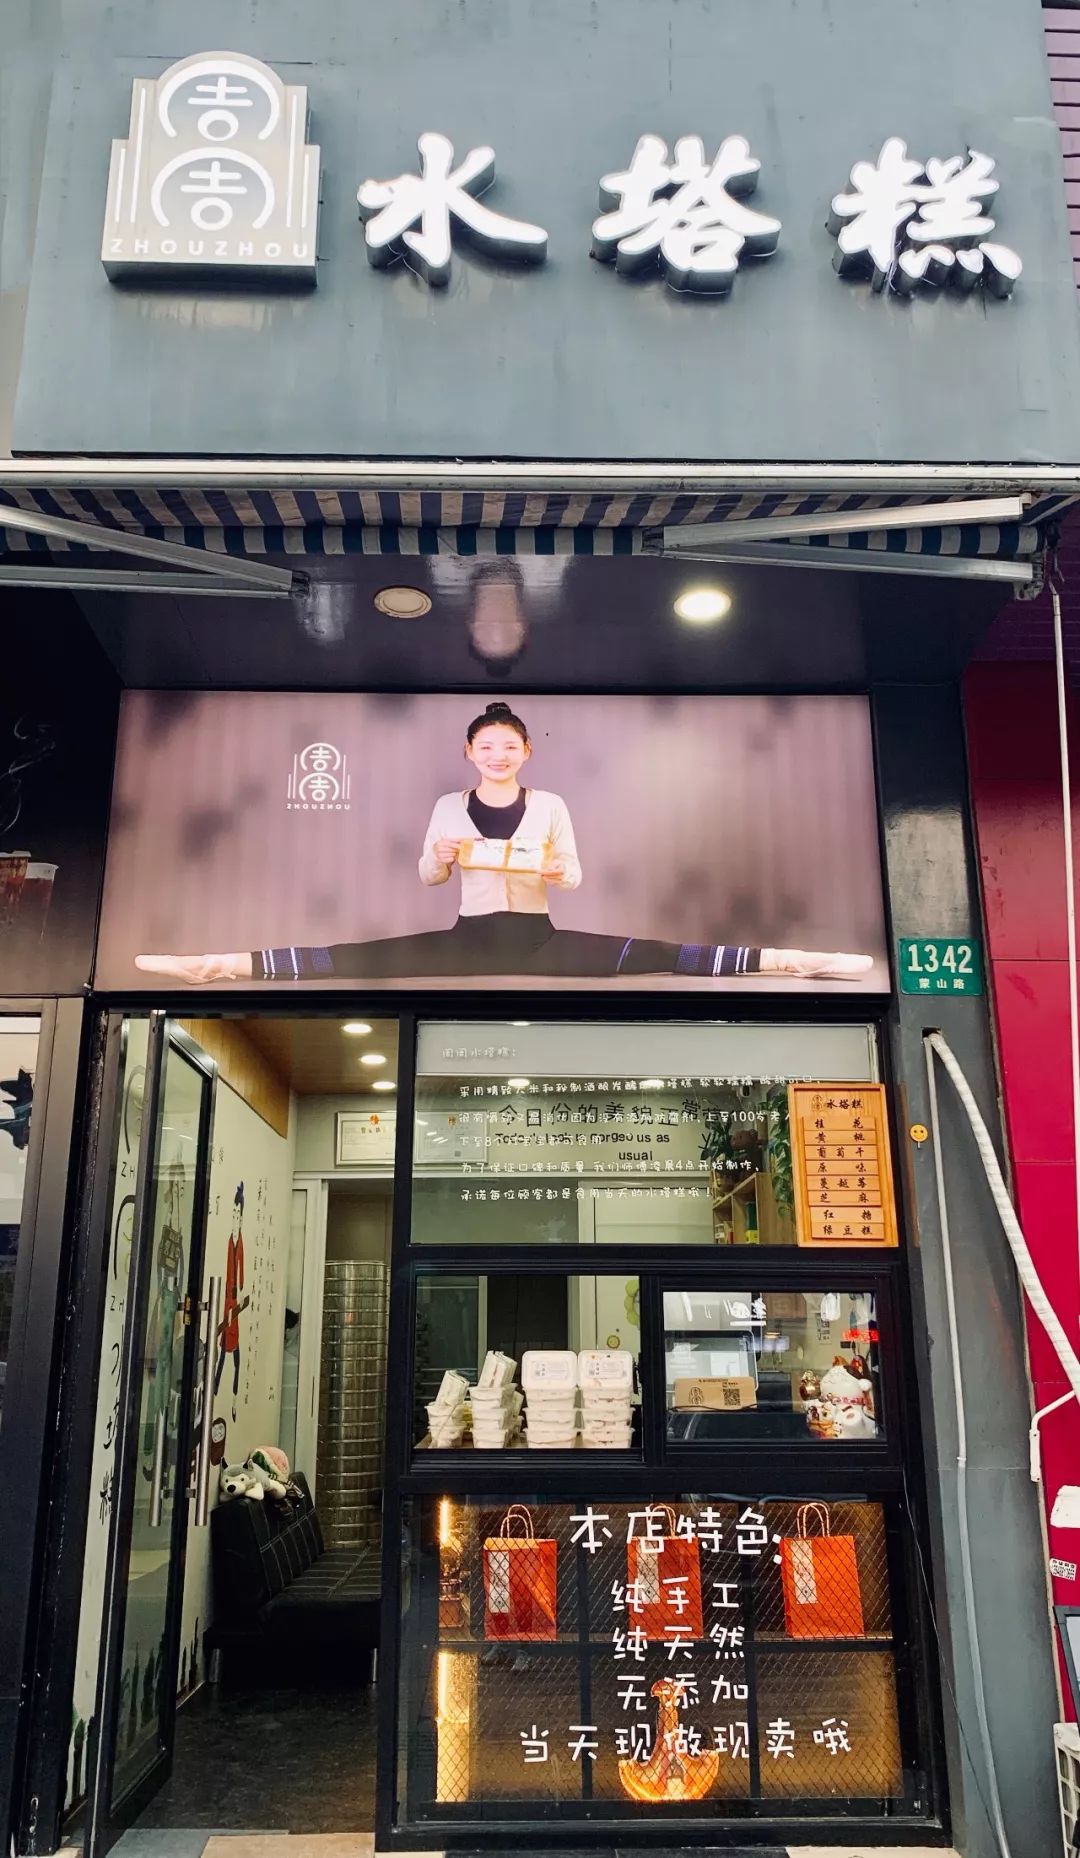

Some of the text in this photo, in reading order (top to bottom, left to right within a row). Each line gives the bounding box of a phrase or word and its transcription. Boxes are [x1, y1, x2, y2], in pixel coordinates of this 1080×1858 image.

[359, 132, 1022, 281] 水塔糕
[111, 238, 308, 258] ZHOUZHOU
[908, 944, 973, 973] 1342
[826, 1098, 863, 1110] 水塔糕
[815, 1117, 864, 1129] 桂花
[656, 1134, 670, 1143] as
[816, 1132, 865, 1143] 黄桃
[618, 1150, 653, 1160] usual
[816, 1147, 865, 1158] 葡萄干
[817, 1165, 867, 1173] 原味
[820, 1192, 869, 1204] 芝麻
[823, 1209, 872, 1220] 红糖
[823, 1224, 873, 1236] 绿豆糕
[569, 1506, 783, 1565] 本店特色：
[611, 1576, 740, 1615] 纯手工
[612, 1624, 746, 1662] 纯天然
[616, 1673, 749, 1711] 无添加
[520, 1717, 852, 1764] 当天现做现卖哦
